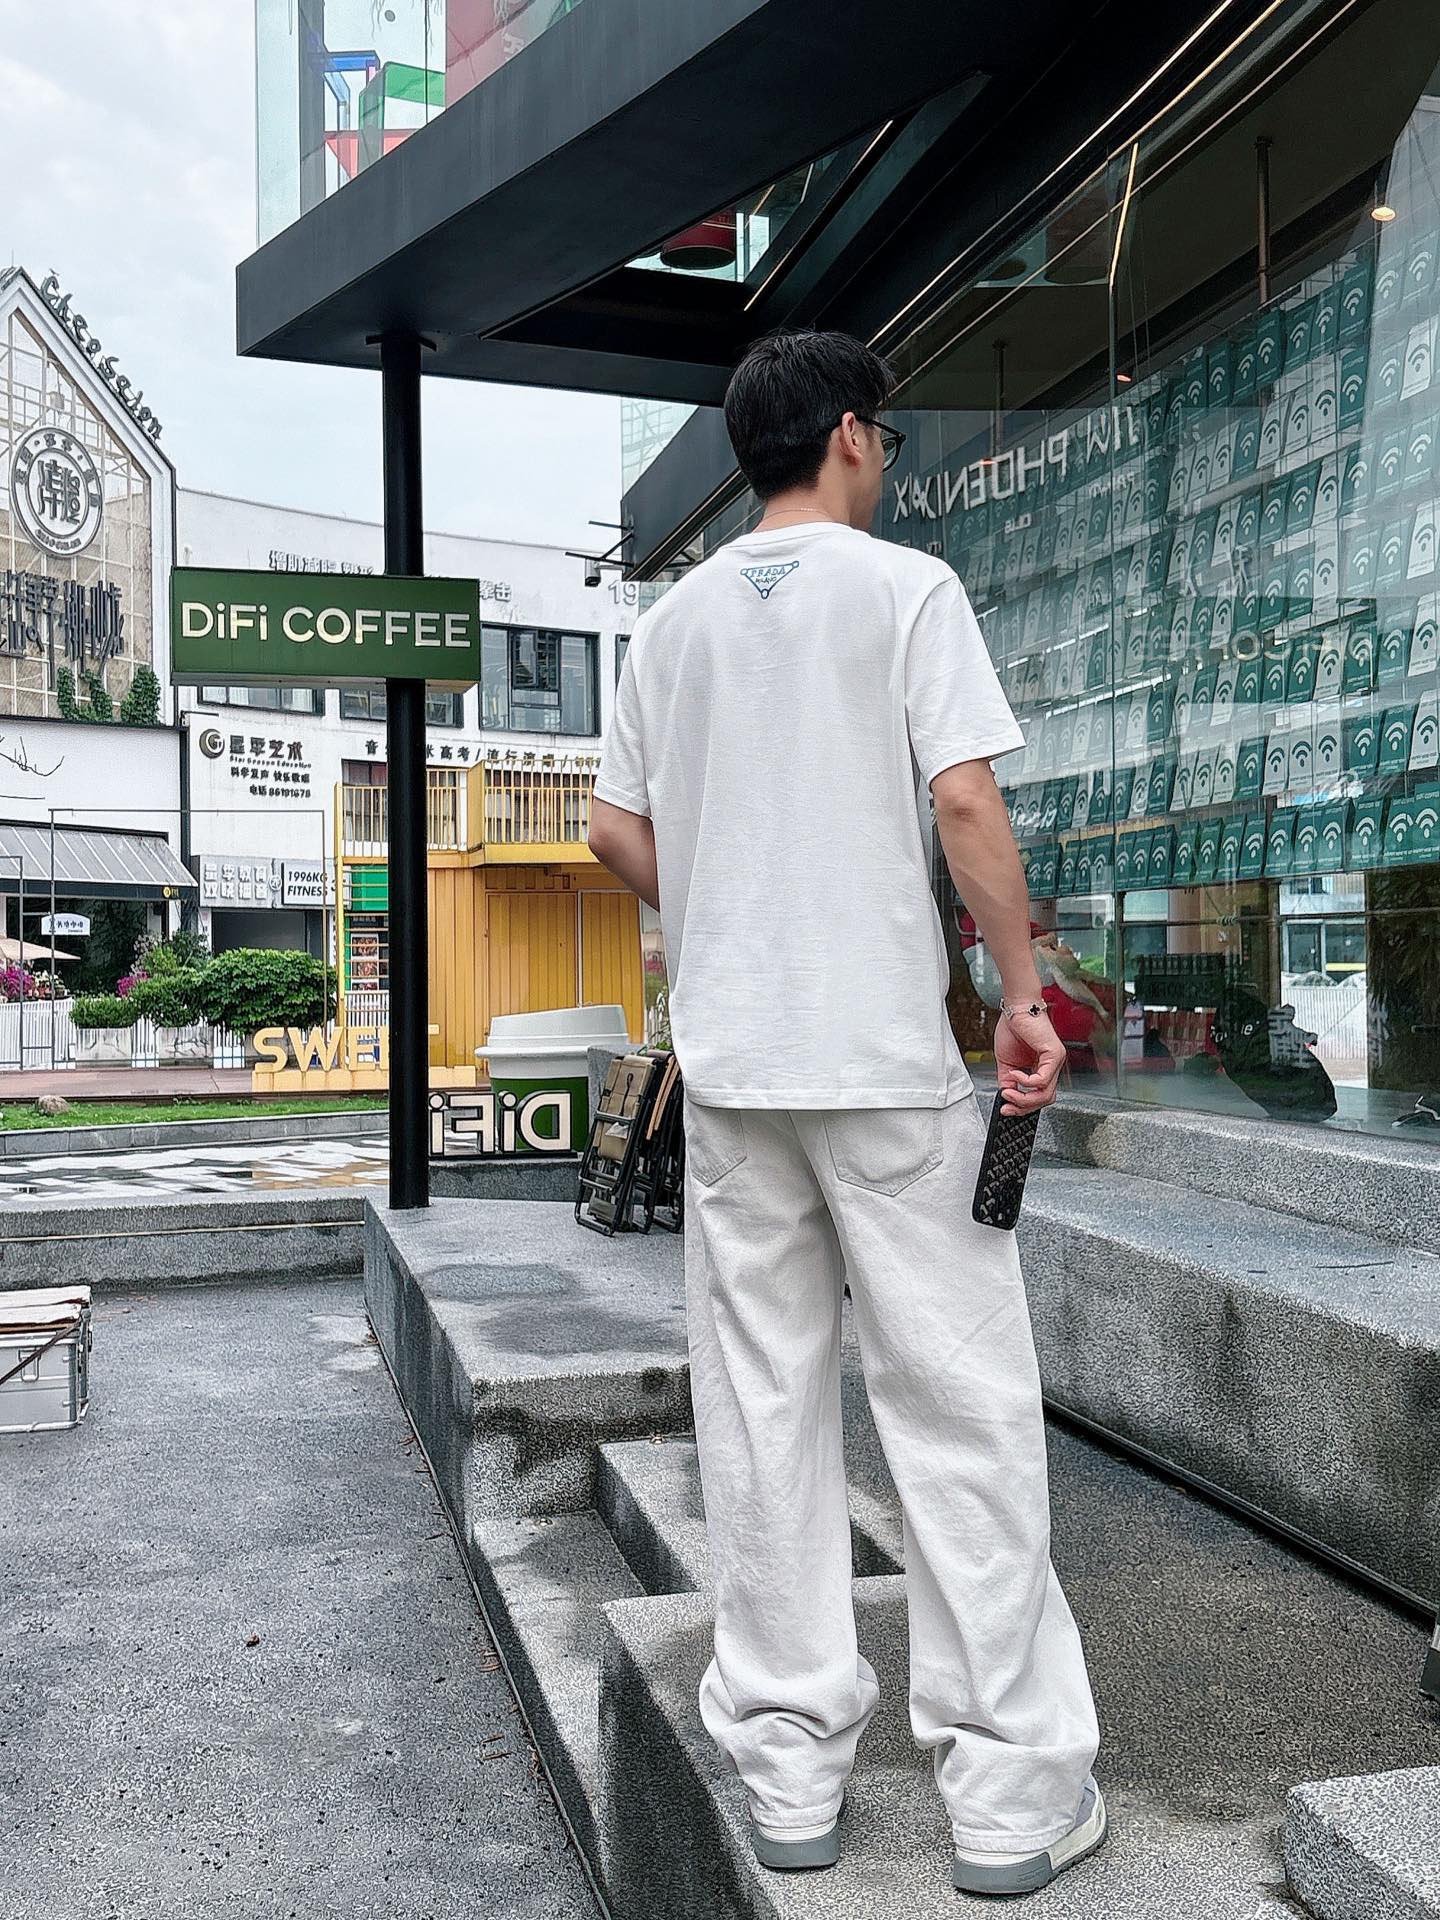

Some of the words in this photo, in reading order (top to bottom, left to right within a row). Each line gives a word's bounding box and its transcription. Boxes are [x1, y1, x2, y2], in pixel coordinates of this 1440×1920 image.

[750, 566, 786, 578] PRADA
[181, 602, 268, 641] DiFi
[282, 606, 471, 648] COFFEE
